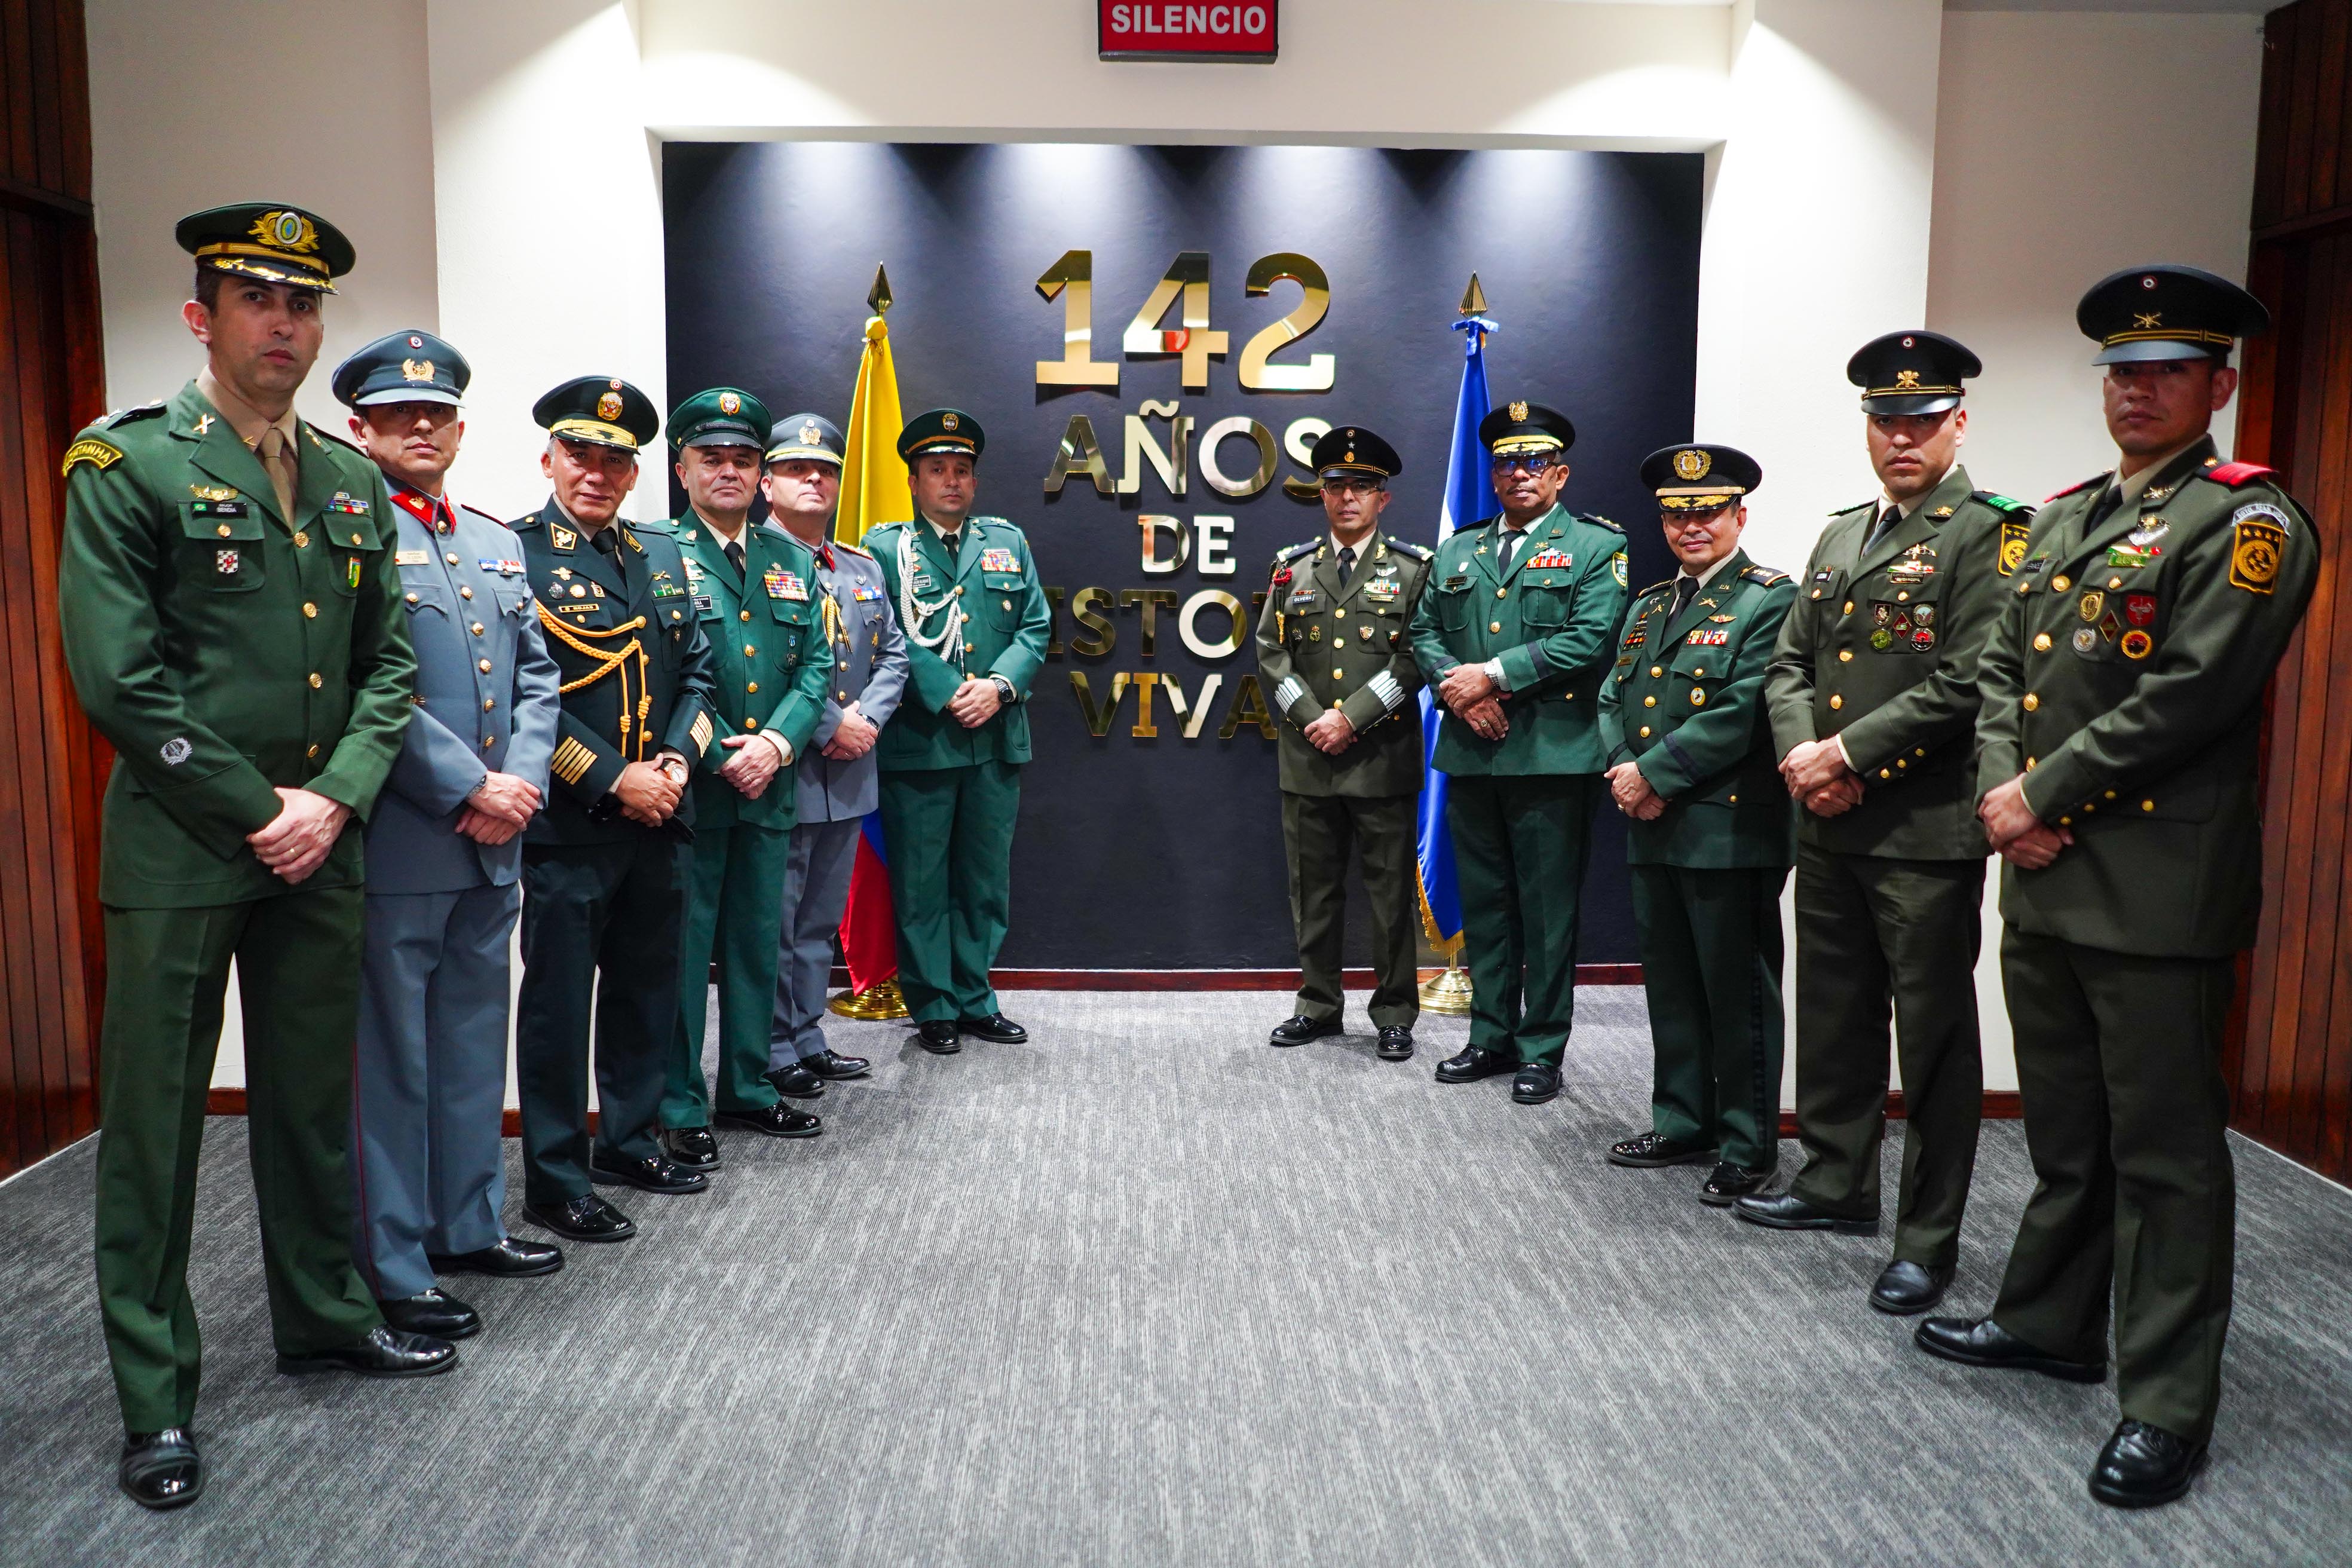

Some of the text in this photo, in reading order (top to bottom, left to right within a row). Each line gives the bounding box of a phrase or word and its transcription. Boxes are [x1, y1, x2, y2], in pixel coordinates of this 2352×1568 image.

[1111, 5, 1266, 34] SILENCIO
[1036, 250, 1335, 390] 142
[1044, 400, 1332, 498] AÑOS
[1138, 515, 1236, 574] DE
[1070, 671, 1277, 739] VIVA
